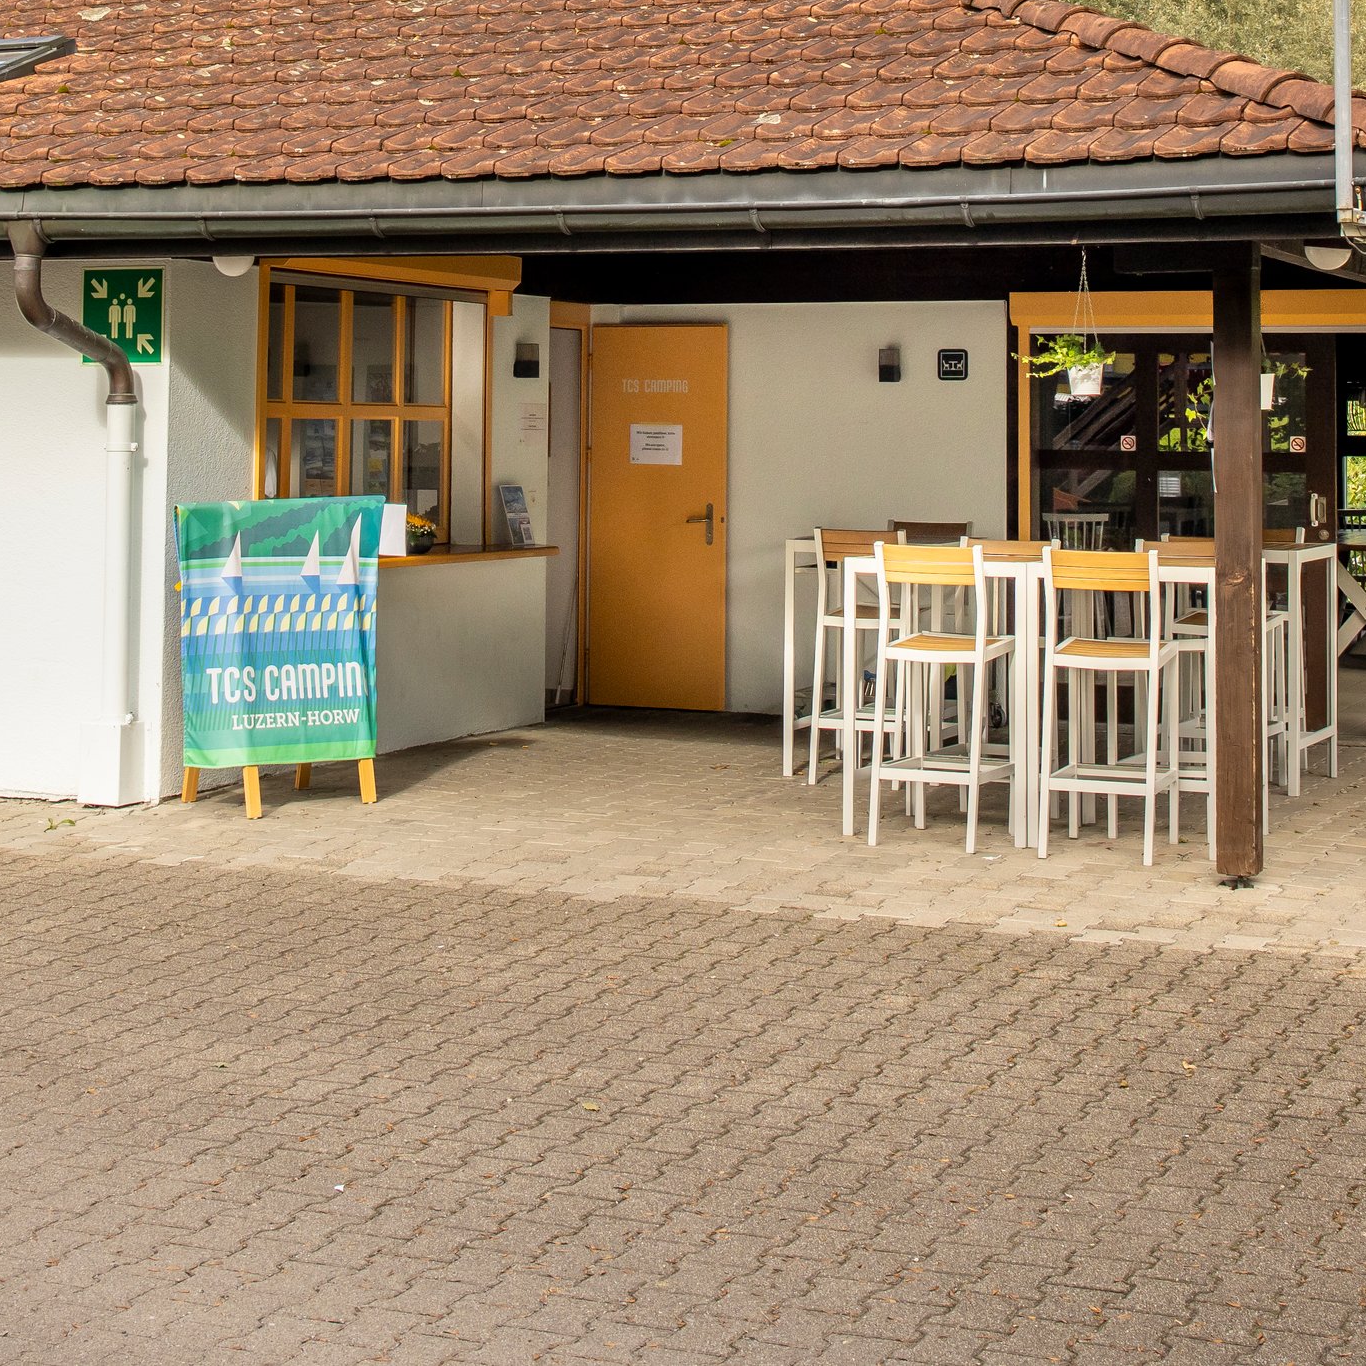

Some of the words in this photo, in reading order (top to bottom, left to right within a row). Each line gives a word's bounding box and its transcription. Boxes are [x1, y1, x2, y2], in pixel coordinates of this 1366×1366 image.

[622, 379, 639, 393] TCS
[644, 379, 688, 394] CAMPING
[206, 666, 257, 704] TCS
[232, 708, 360, 731] LUZERN-HORW
